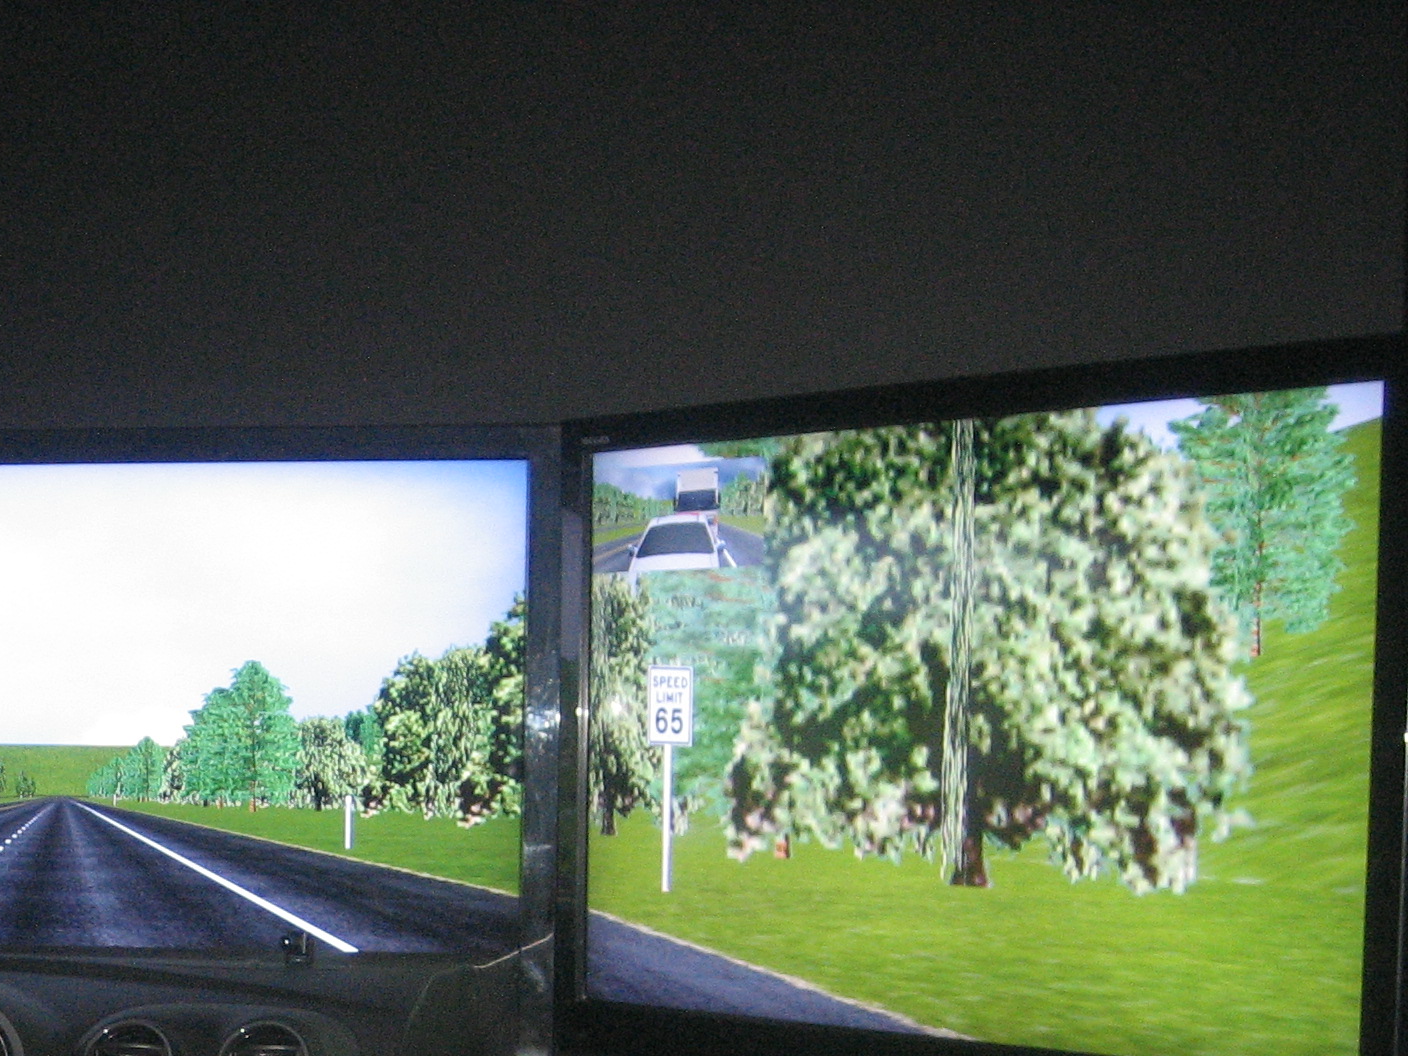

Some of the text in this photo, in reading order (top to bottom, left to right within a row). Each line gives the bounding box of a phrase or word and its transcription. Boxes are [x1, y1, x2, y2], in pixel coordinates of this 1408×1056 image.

[653, 675, 688, 688] SPEED
[656, 692, 683, 703] LIMIT
[655, 707, 683, 734] 65
